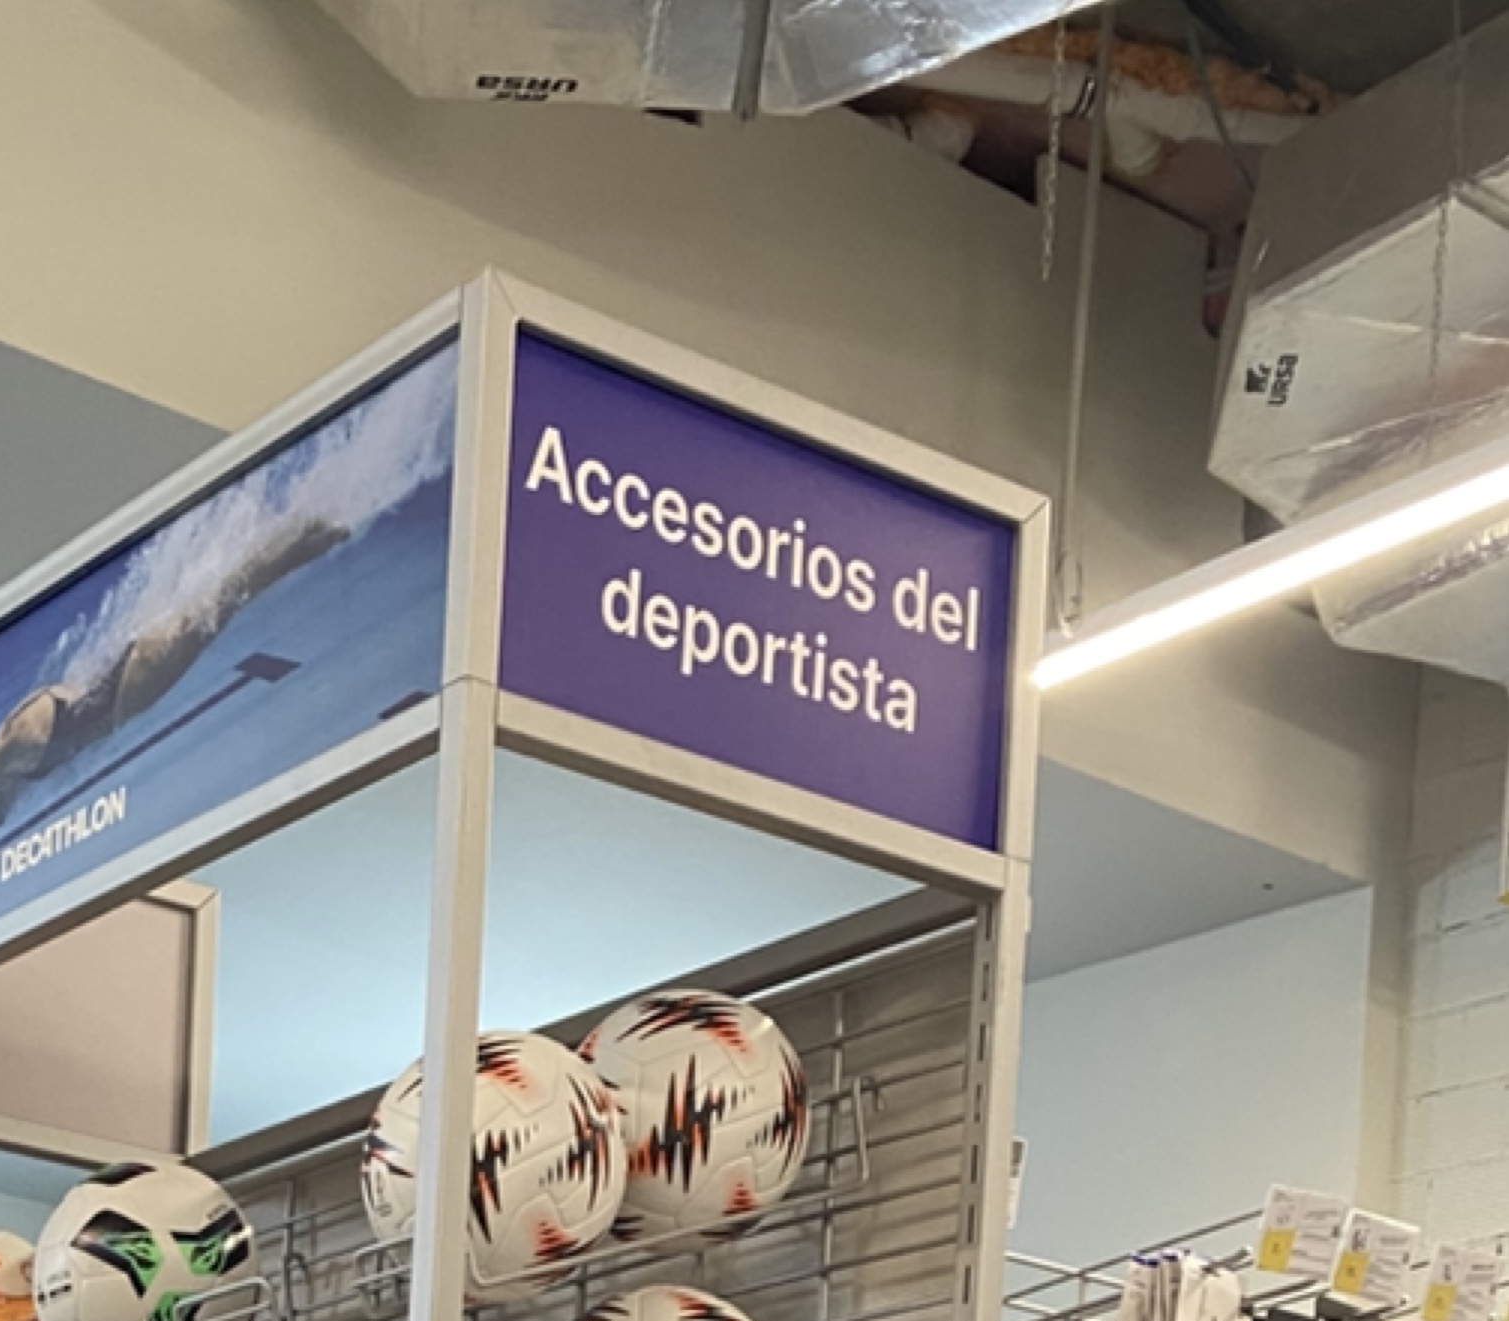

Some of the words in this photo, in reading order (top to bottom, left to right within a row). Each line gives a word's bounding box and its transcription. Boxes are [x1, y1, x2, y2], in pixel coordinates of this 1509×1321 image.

[525, 426, 876, 613] Accesorios
[891, 568, 980, 651] del
[601, 569, 918, 733] deportista
[1, 785, 126, 882] DECATHLON
